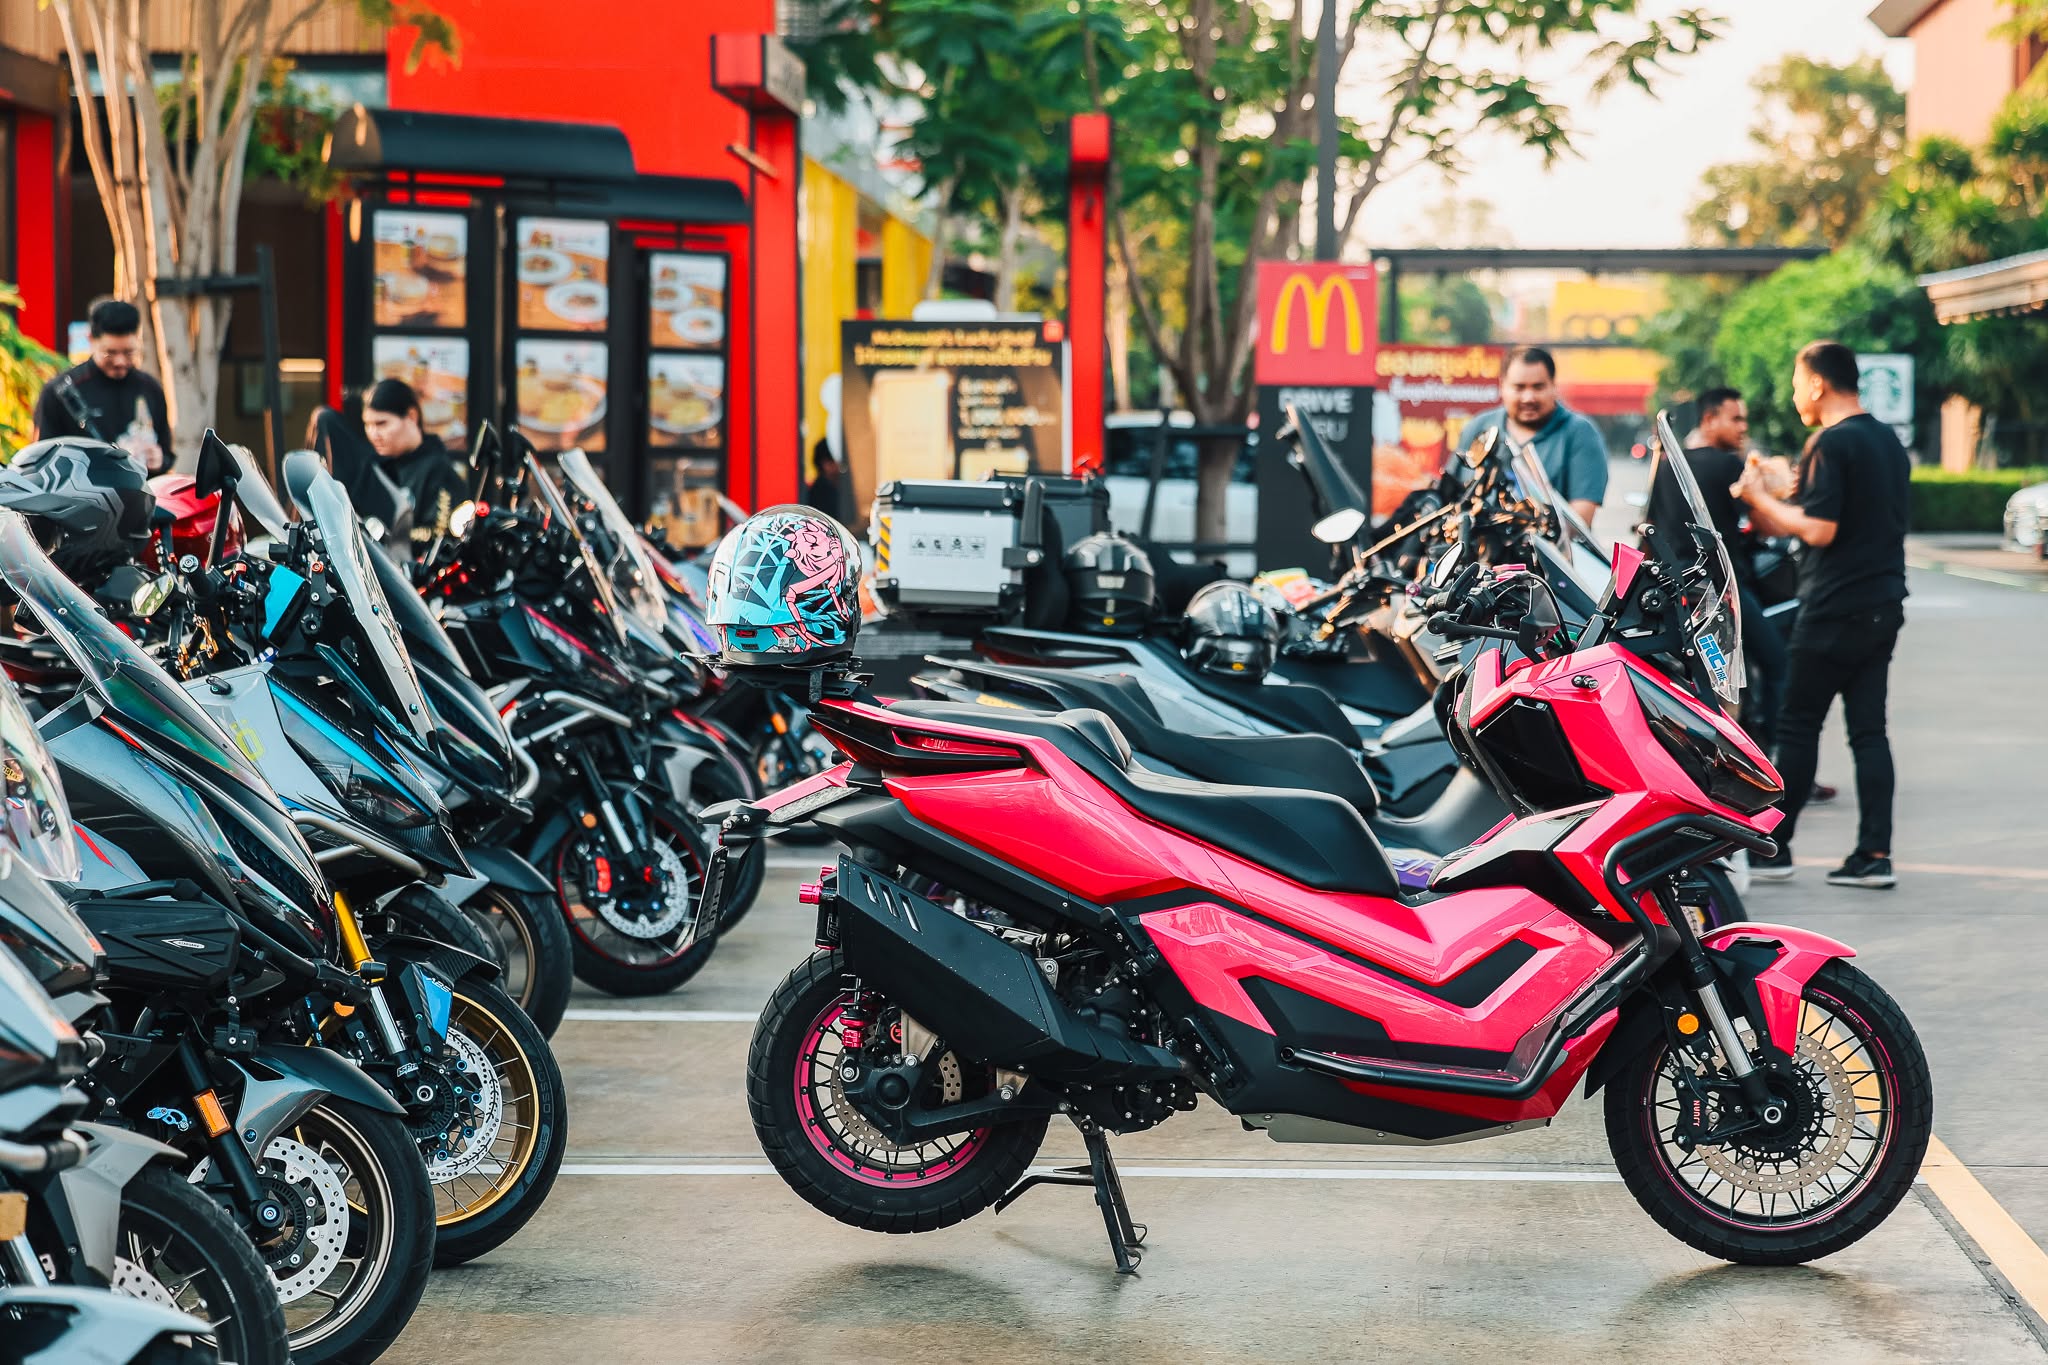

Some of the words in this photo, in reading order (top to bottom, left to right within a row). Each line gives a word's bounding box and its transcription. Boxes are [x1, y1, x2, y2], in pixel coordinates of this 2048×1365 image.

[1278, 388, 1352, 413] DRIVE
[1715, 667, 1727, 682] TIRE
[535, 1060, 551, 1114] ROSSO
[530, 1132, 549, 1174] SPORT
